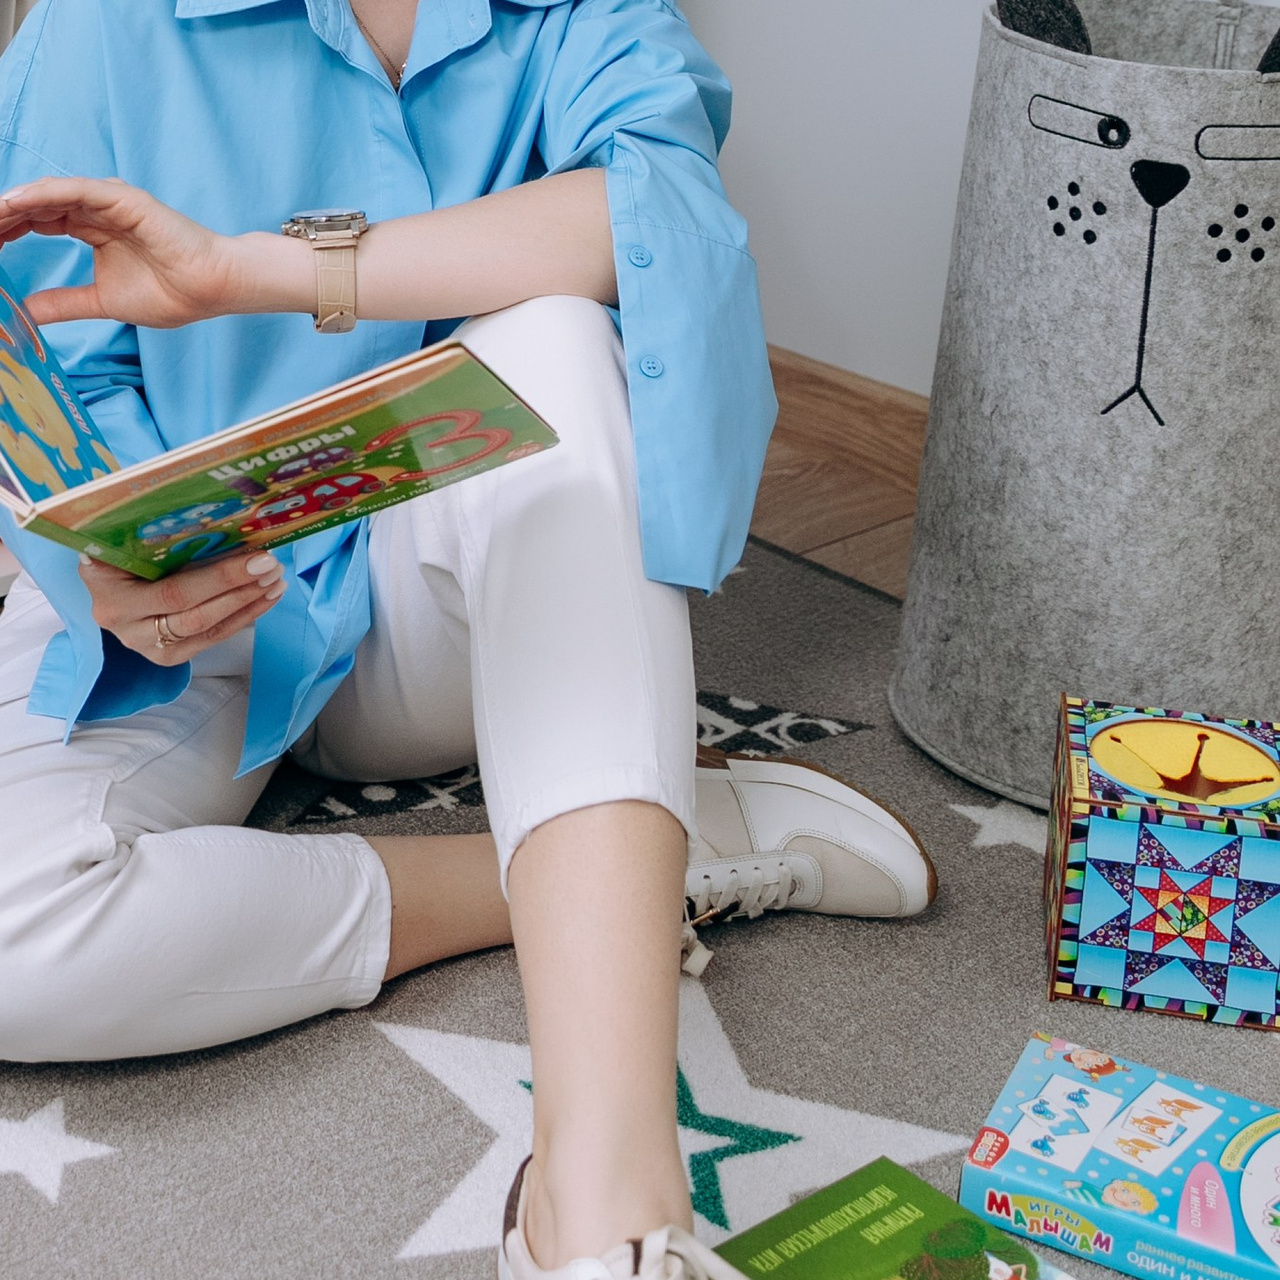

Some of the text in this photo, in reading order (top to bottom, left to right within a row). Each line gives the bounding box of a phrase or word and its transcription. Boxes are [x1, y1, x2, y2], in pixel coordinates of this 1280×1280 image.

[207, 425, 357, 481] Цифры
[364, 408, 513, 481] 3
[1028, 1201, 1081, 1227] ИГРЫ
[1205, 1179, 1219, 1209] Один
[860, 1202, 925, 1245] РИТМИЧНАЯ
[987, 1190, 1113, 1253] МАЛЫШАМ
[748, 1247, 784, 1273] ИГРА
